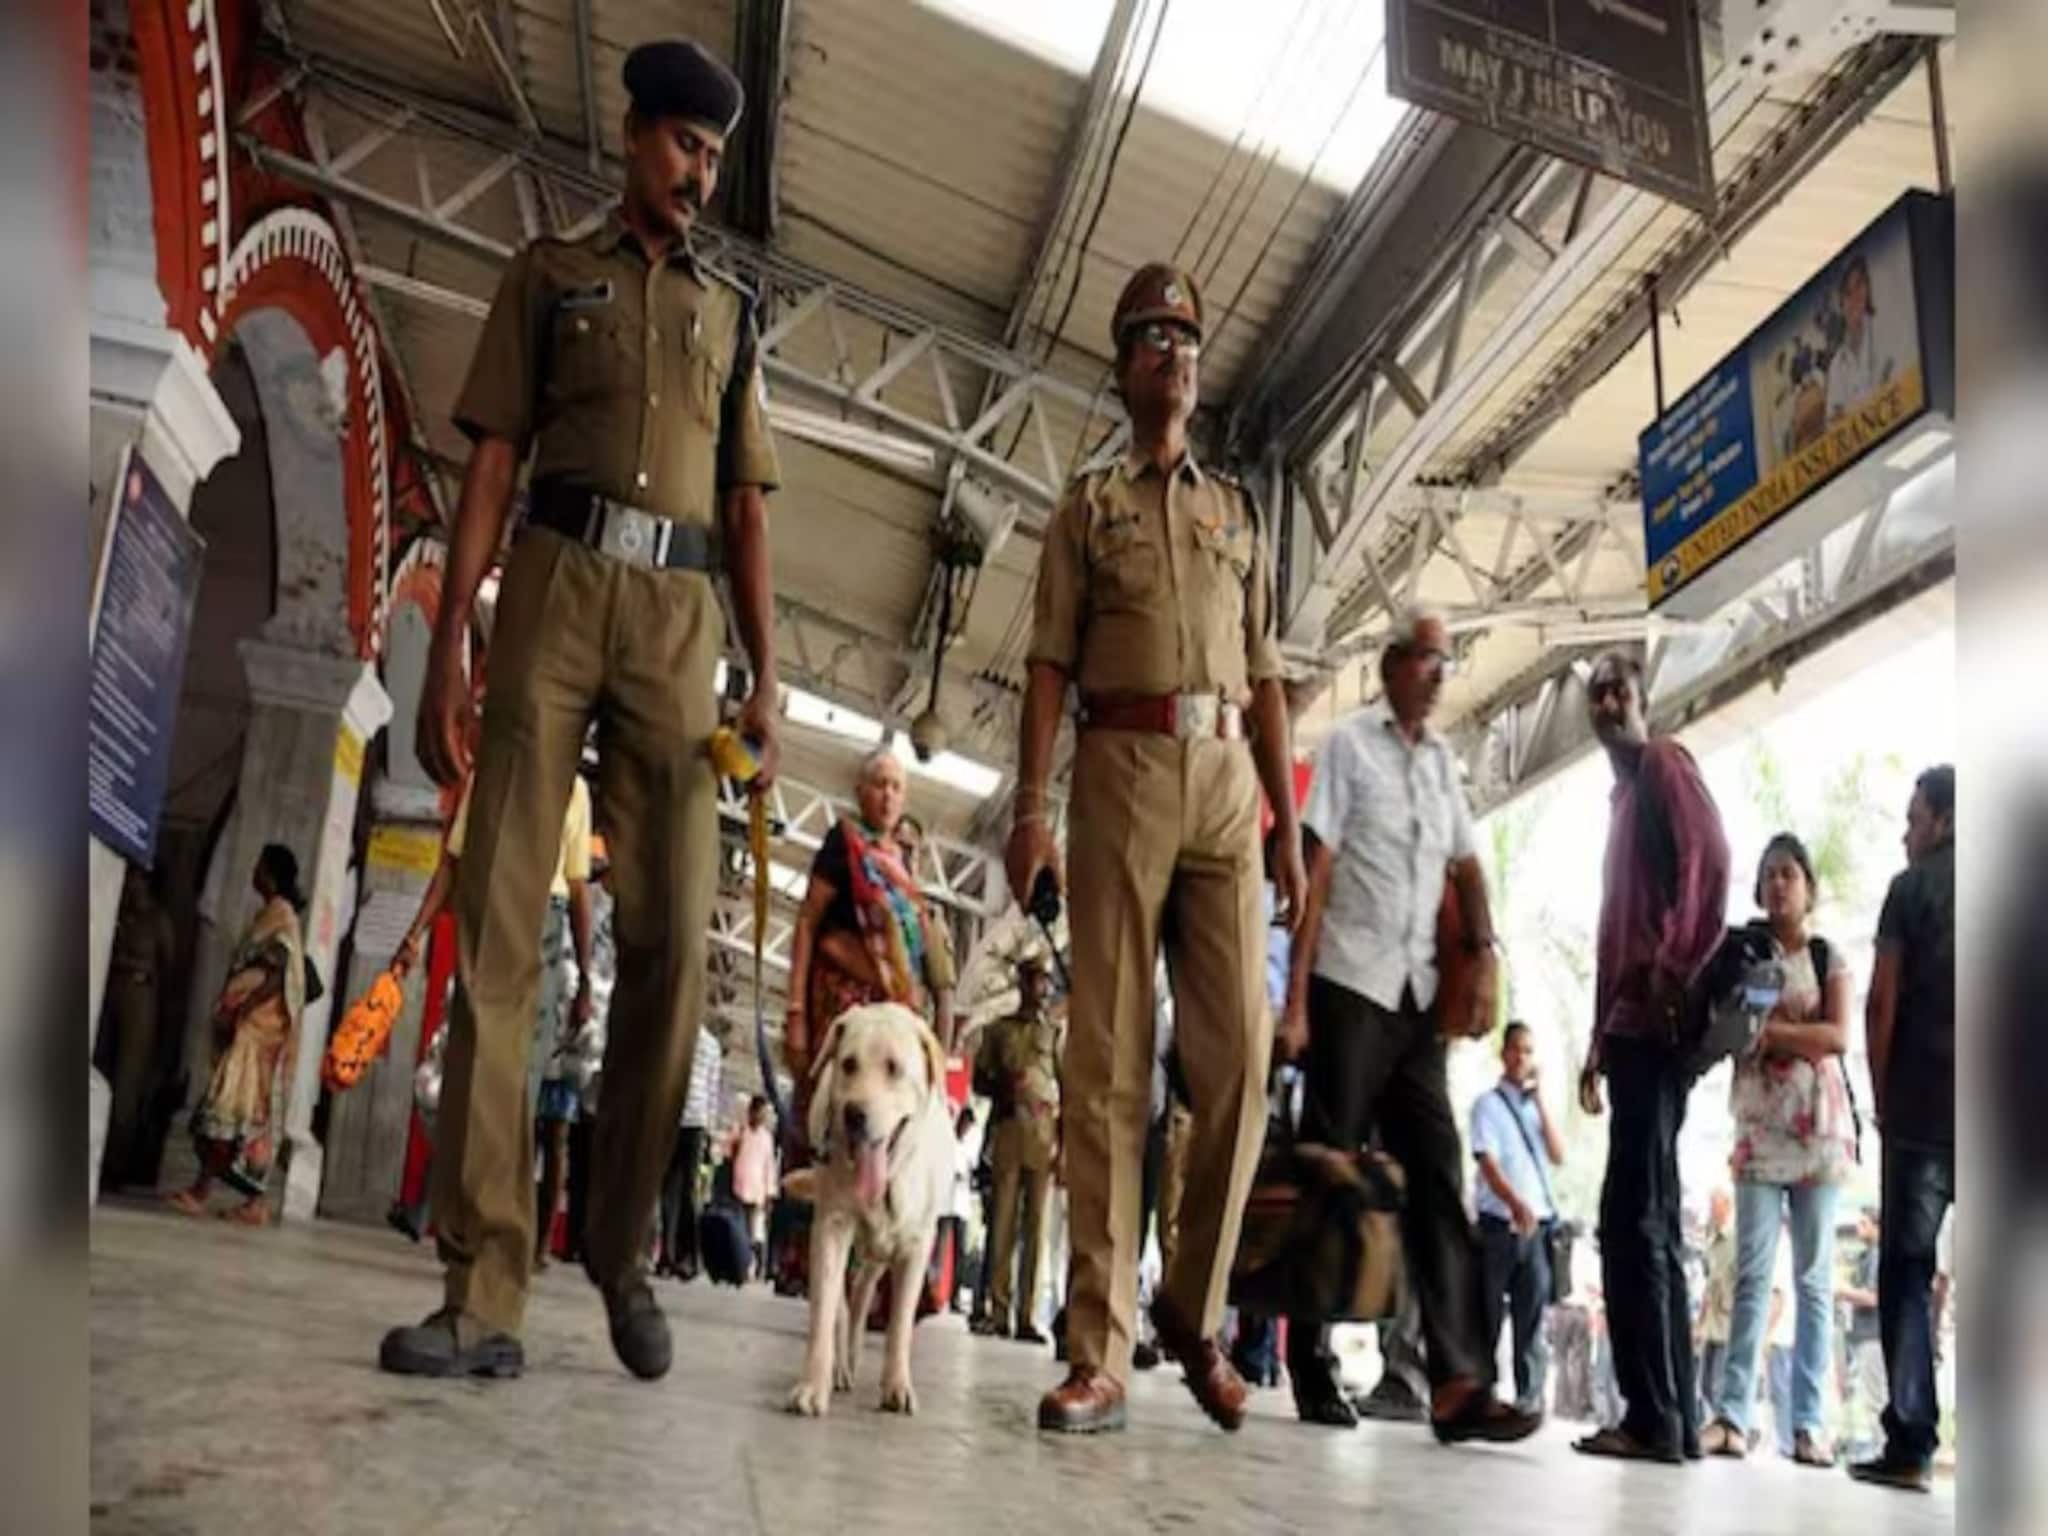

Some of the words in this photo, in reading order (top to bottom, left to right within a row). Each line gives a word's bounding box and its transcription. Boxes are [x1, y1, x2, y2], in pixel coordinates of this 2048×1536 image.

[1438, 37, 1502, 94] MAY
[1533, 74, 1606, 125] HELP
[1613, 97, 1671, 156] YOU
[1680, 508, 1741, 570] UNITED
[1742, 474, 1790, 531] INDIA
[1793, 387, 1902, 490] INSURANCE
